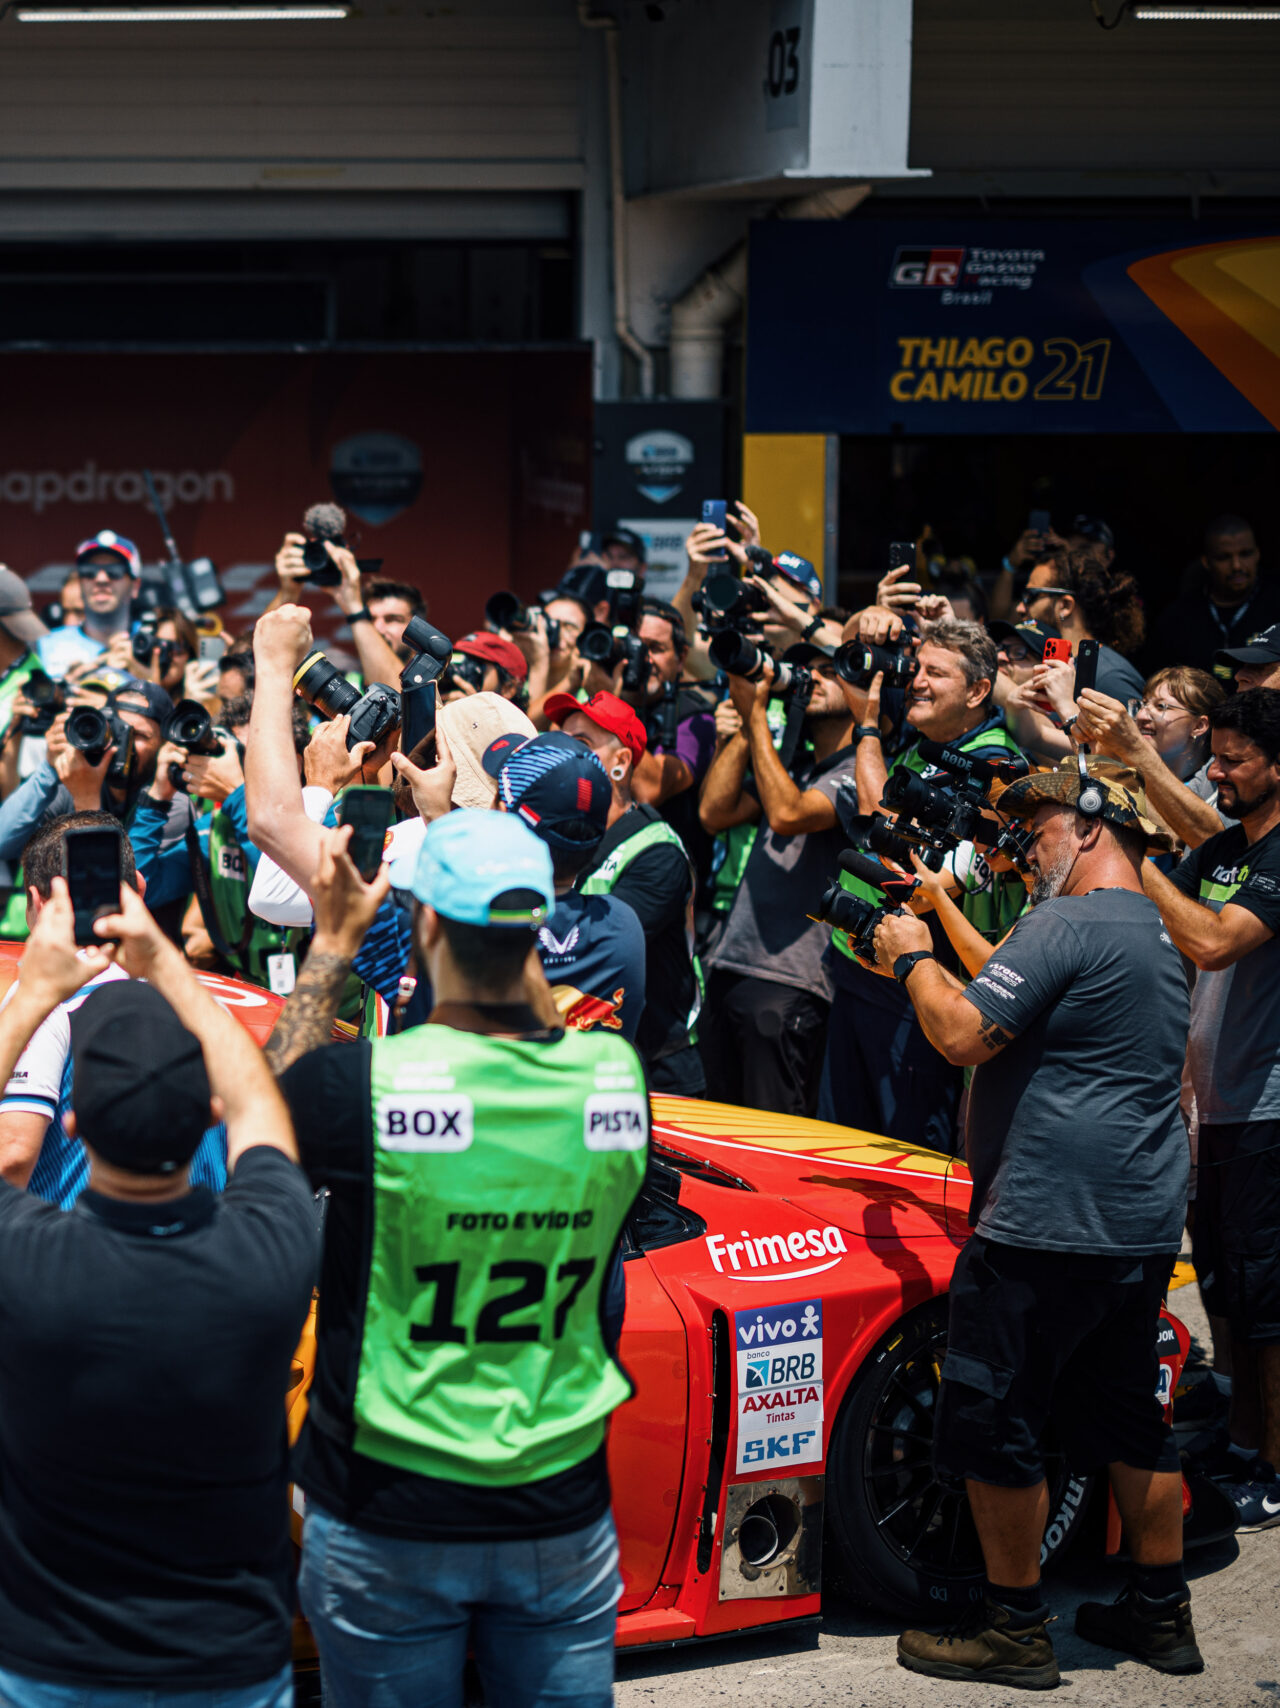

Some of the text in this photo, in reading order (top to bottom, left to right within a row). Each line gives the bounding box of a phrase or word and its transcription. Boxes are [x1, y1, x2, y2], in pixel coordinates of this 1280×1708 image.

[767, 27, 800, 98] 03
[894, 262, 960, 286] GR
[897, 336, 1035, 368] THIAGO
[1033, 337, 1112, 400] 21
[889, 370, 1029, 402] CAMILO
[941, 750, 974, 772] RØDE
[386, 1110, 462, 1137] BOX
[589, 1110, 643, 1132] PISTA
[446, 1211, 510, 1232] FOTO
[512, 1211, 527, 1231] E
[705, 1226, 848, 1273] Frimesa
[408, 1257, 598, 1345] 127
[738, 1315, 796, 1345] vivo
[746, 1350, 771, 1360] banco
[770, 1352, 816, 1385] BRB
[742, 1386, 820, 1415] AXALTA
[766, 1411, 796, 1424] Tintas
[742, 1429, 817, 1464] SKF
